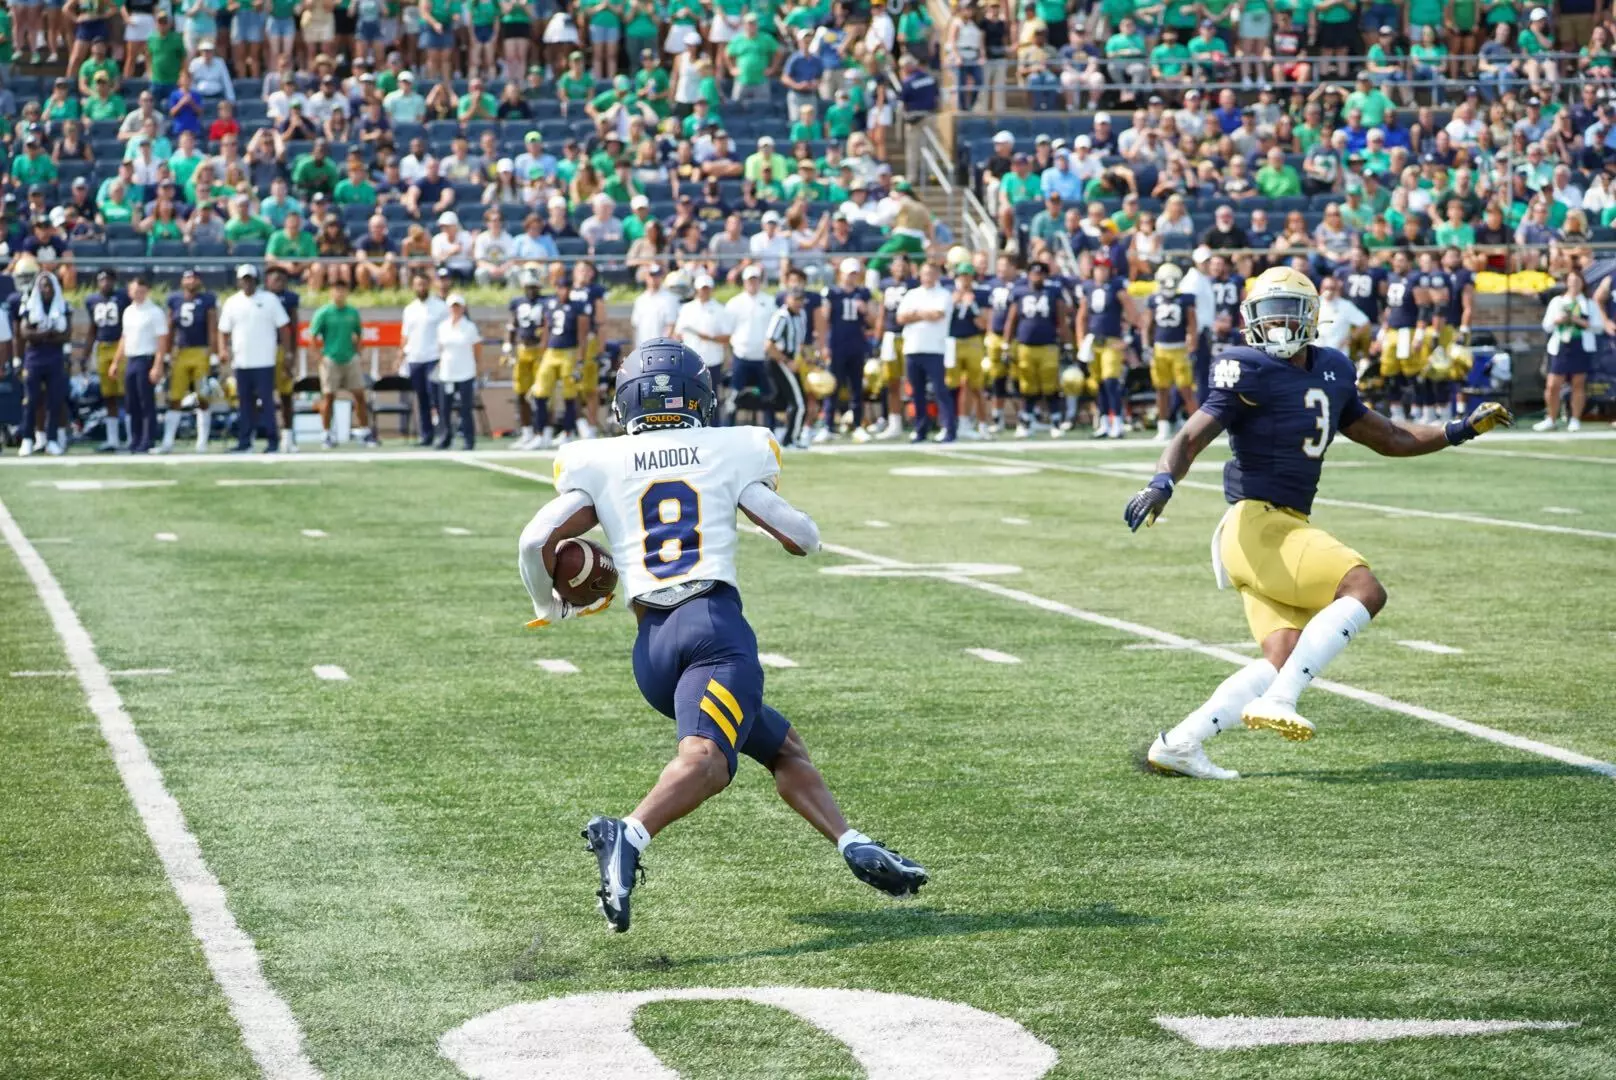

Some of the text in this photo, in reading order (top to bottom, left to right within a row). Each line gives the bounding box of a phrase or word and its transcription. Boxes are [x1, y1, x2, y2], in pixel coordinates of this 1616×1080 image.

[180, 302, 195, 327] 5
[645, 414, 681, 424] TOLEDO
[1302, 387, 1330, 459] 3
[633, 446, 701, 472] MADDOX
[638, 478, 702, 582] 8
